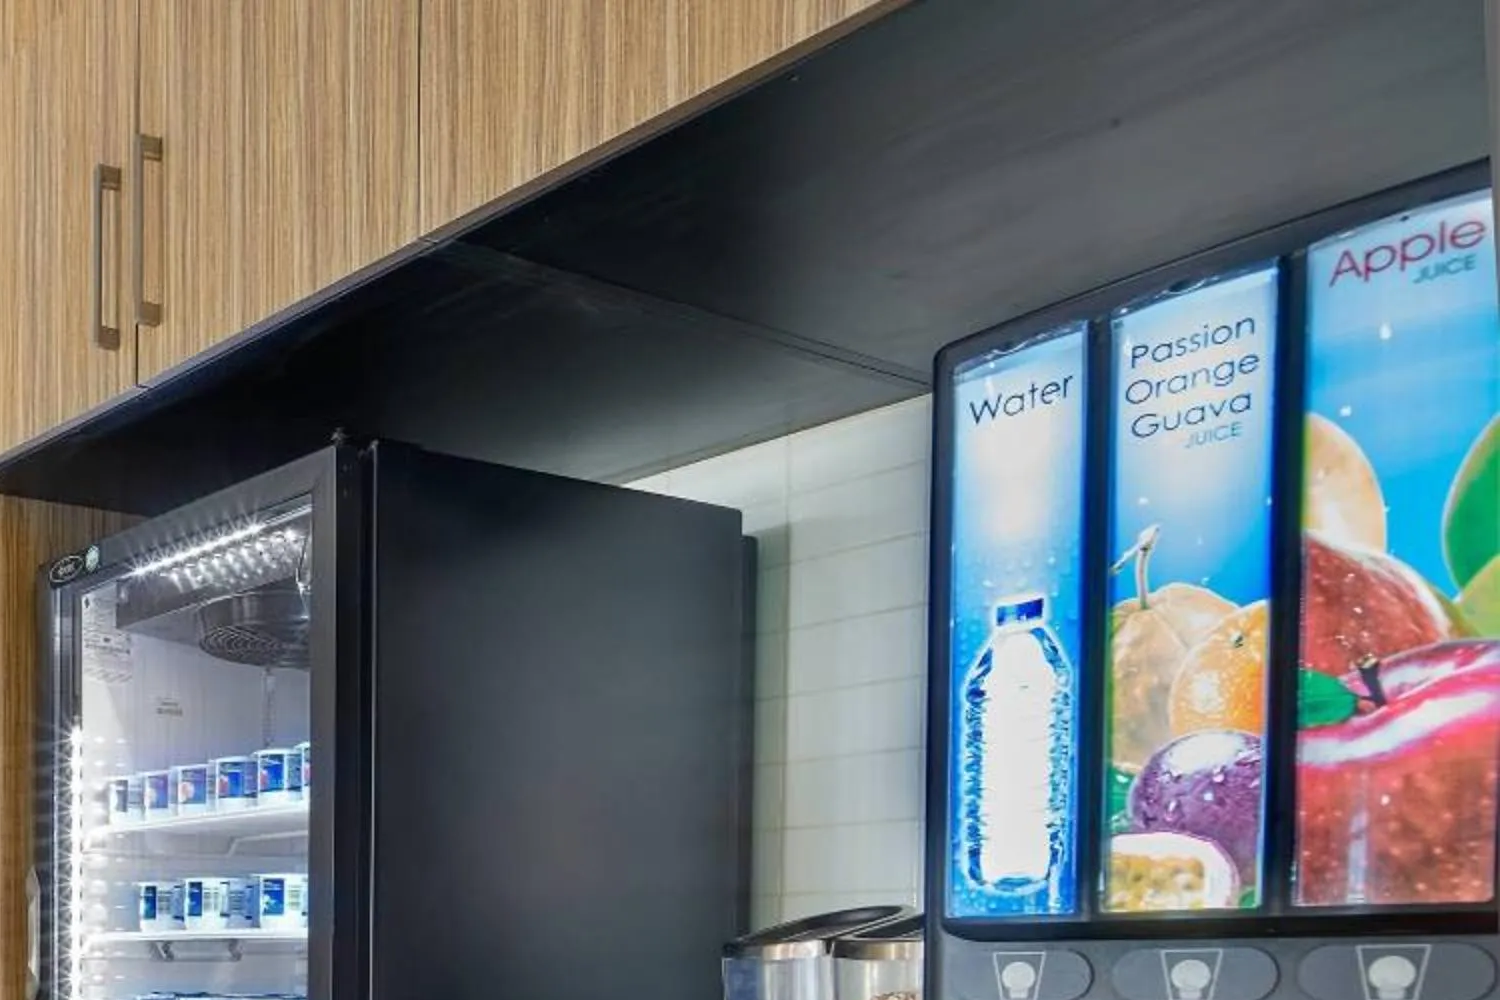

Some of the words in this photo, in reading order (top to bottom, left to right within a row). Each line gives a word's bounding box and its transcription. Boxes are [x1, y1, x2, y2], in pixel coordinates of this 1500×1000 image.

[1329, 215, 1486, 287] Apple
[1413, 253, 1476, 284] JUICE
[1131, 317, 1255, 369] Passion
[969, 375, 1073, 425] Water
[1126, 354, 1260, 404] Orange
[1131, 393, 1252, 438] Guava
[1184, 421, 1242, 448] JUICE
